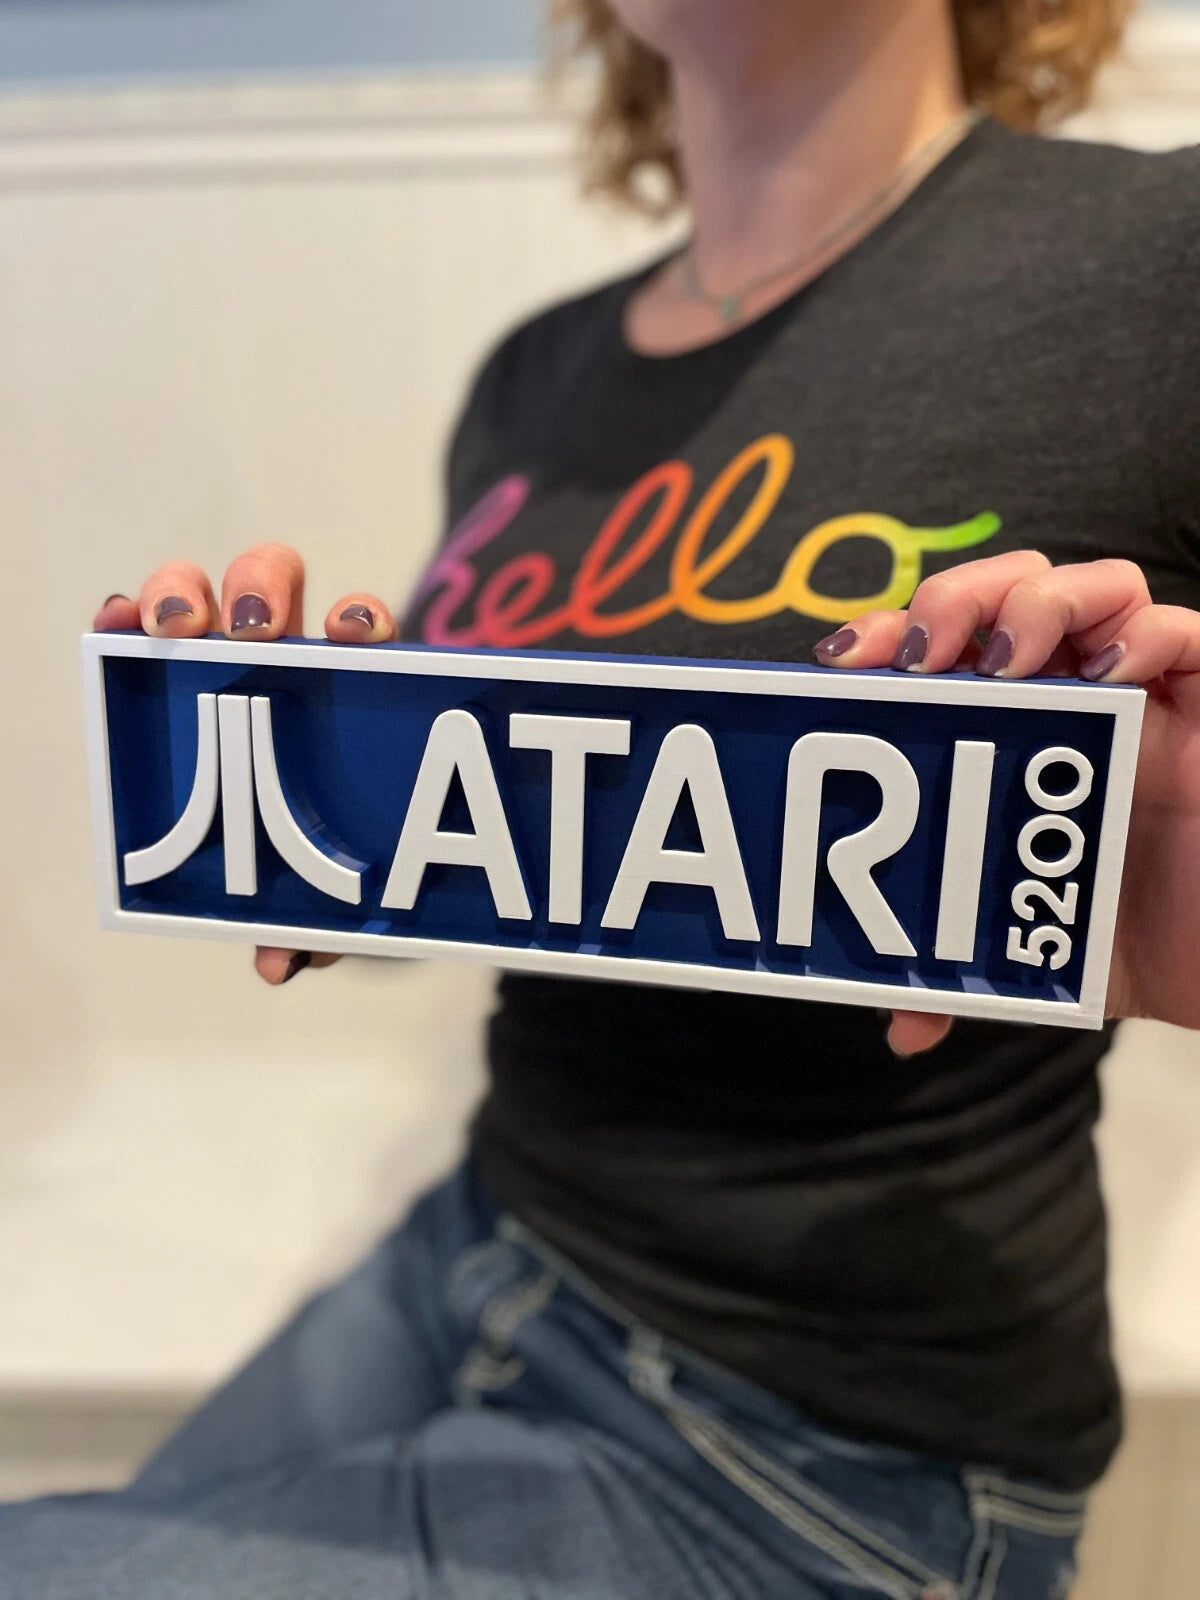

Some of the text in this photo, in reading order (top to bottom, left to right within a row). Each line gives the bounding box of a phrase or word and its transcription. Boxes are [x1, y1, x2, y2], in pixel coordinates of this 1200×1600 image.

[409, 434, 1001, 646] hello
[381, 709, 995, 963] ATARI
[1006, 746, 1094, 971] 5200
